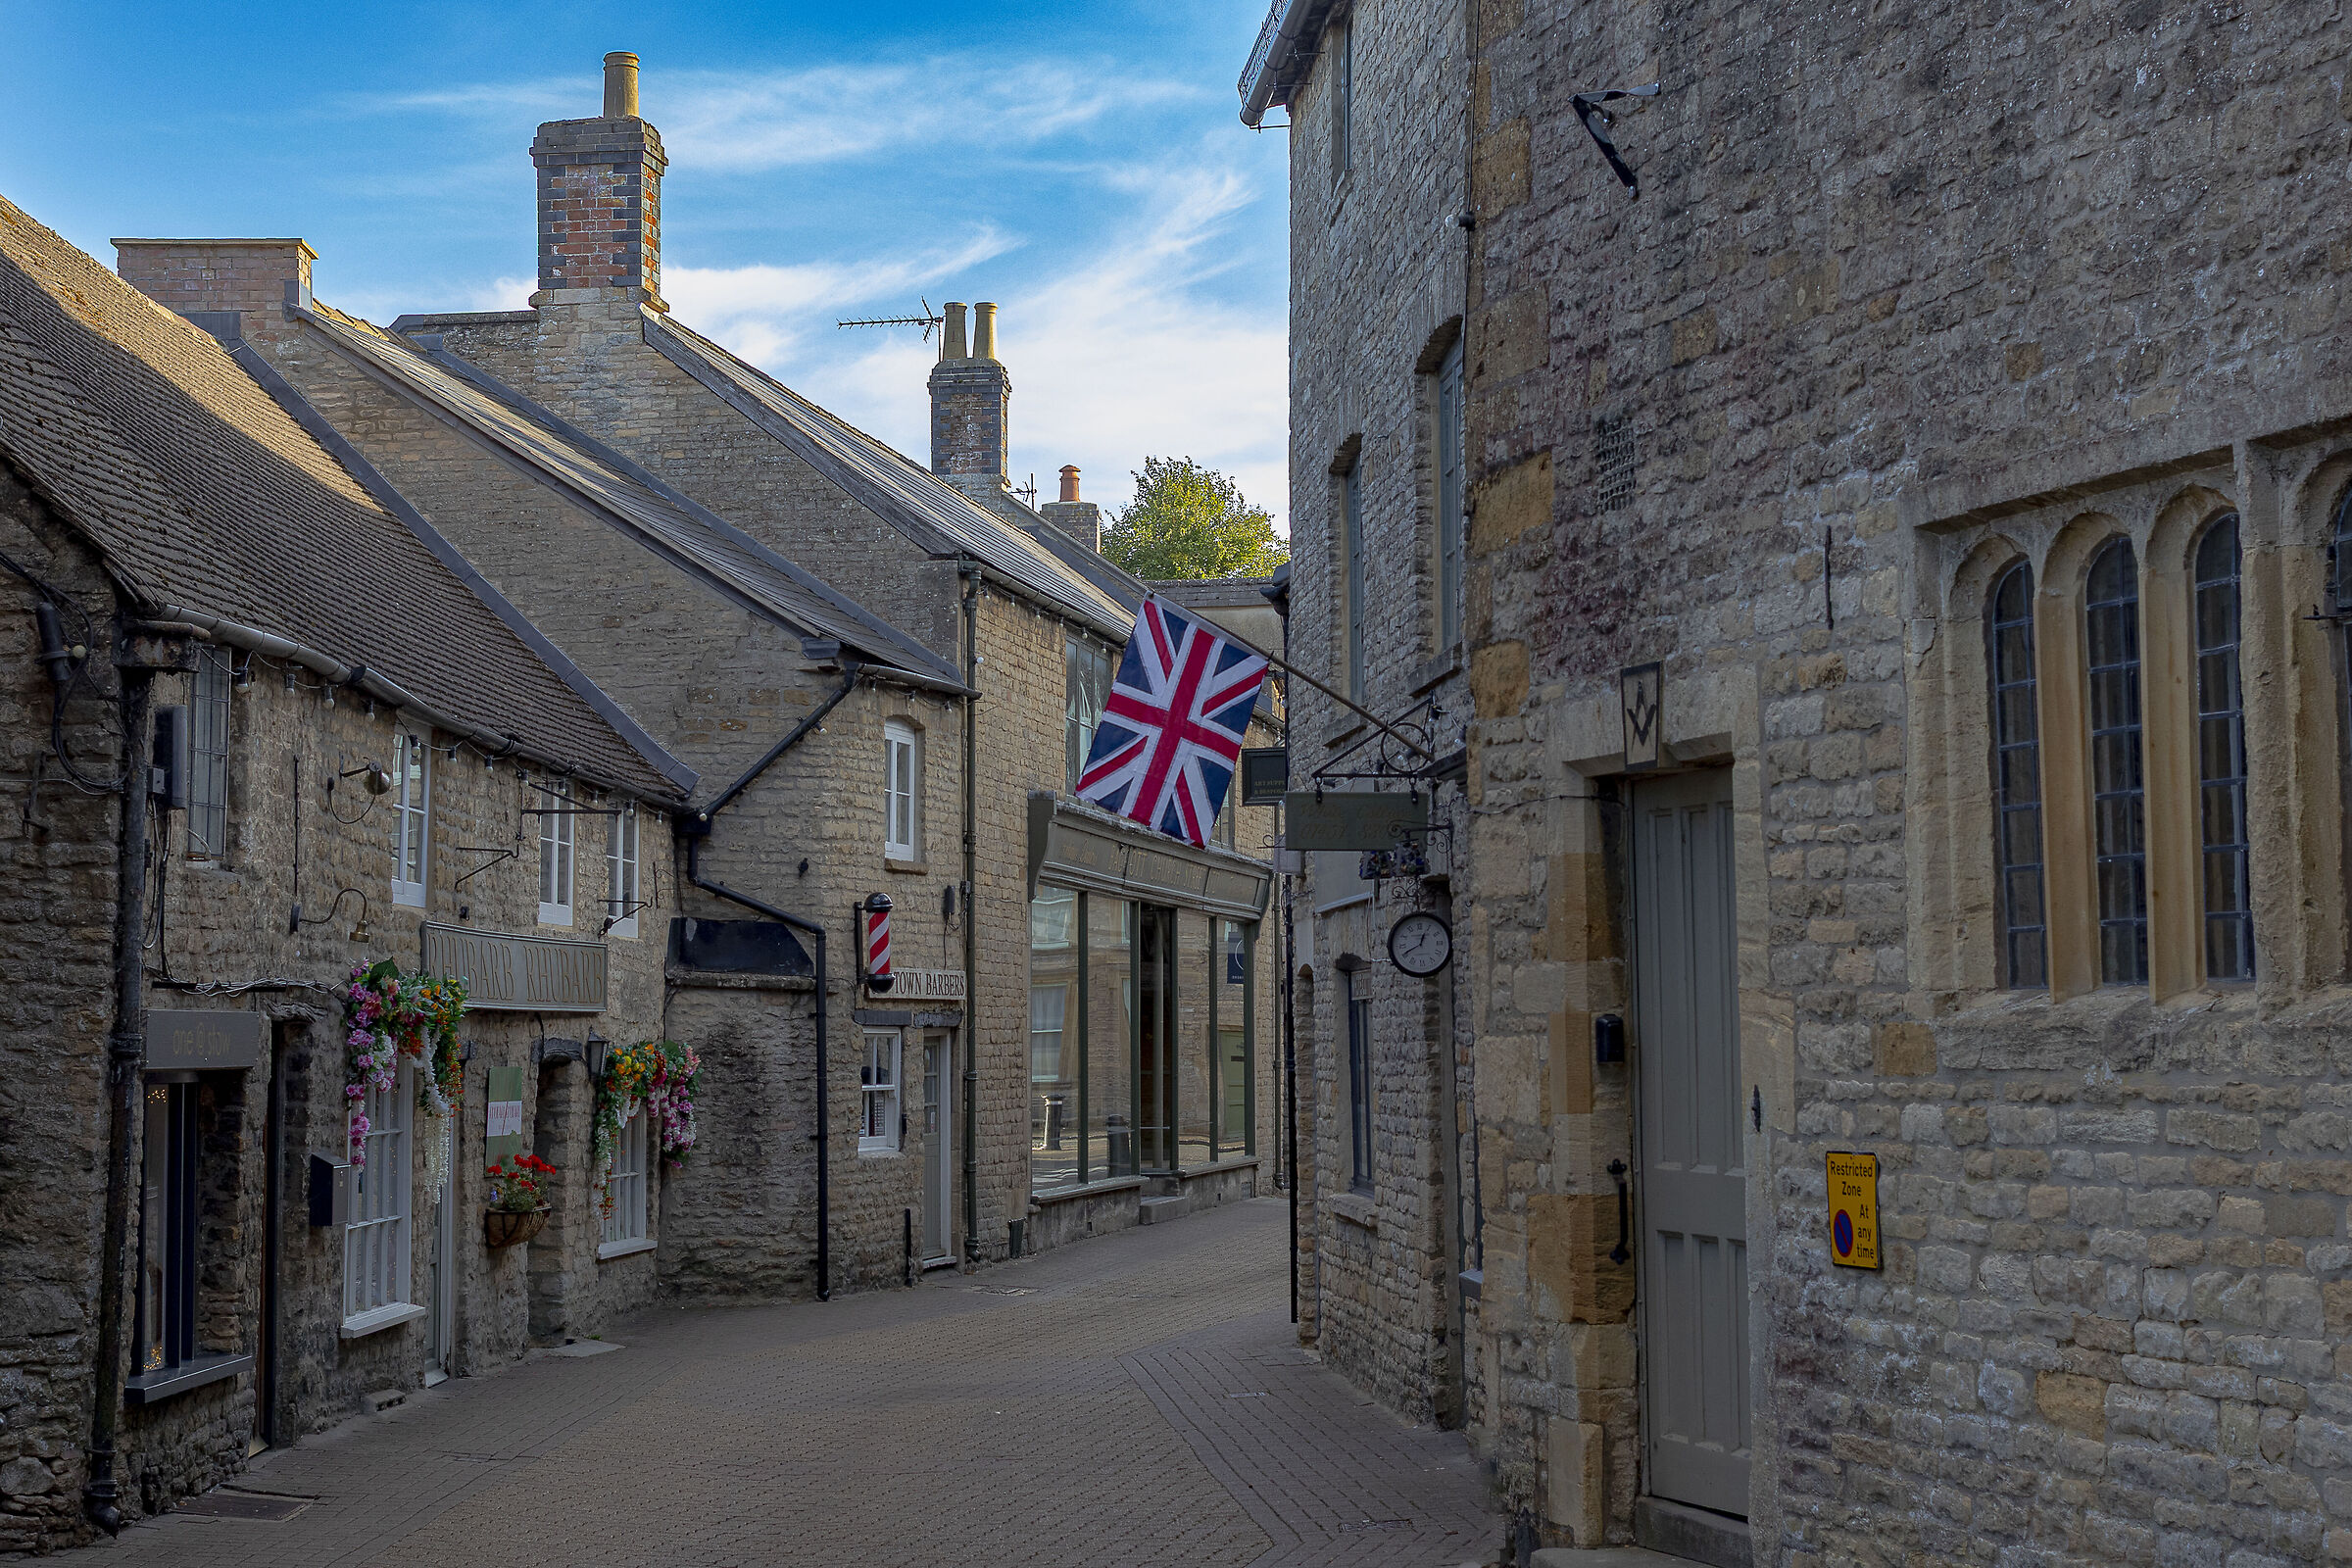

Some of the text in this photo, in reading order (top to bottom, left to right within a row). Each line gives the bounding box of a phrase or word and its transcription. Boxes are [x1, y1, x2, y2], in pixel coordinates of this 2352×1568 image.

[426, 932, 604, 1004] RHUBARB RHUBARB
[893, 971, 965, 997] TOWN BARBERS
[1830, 1160, 1873, 1178] Restricted
[1841, 1181, 1862, 1197] Zone
[1859, 1203, 1869, 1219] At
[1857, 1226, 1872, 1242] any
[1857, 1243, 1874, 1259] time
